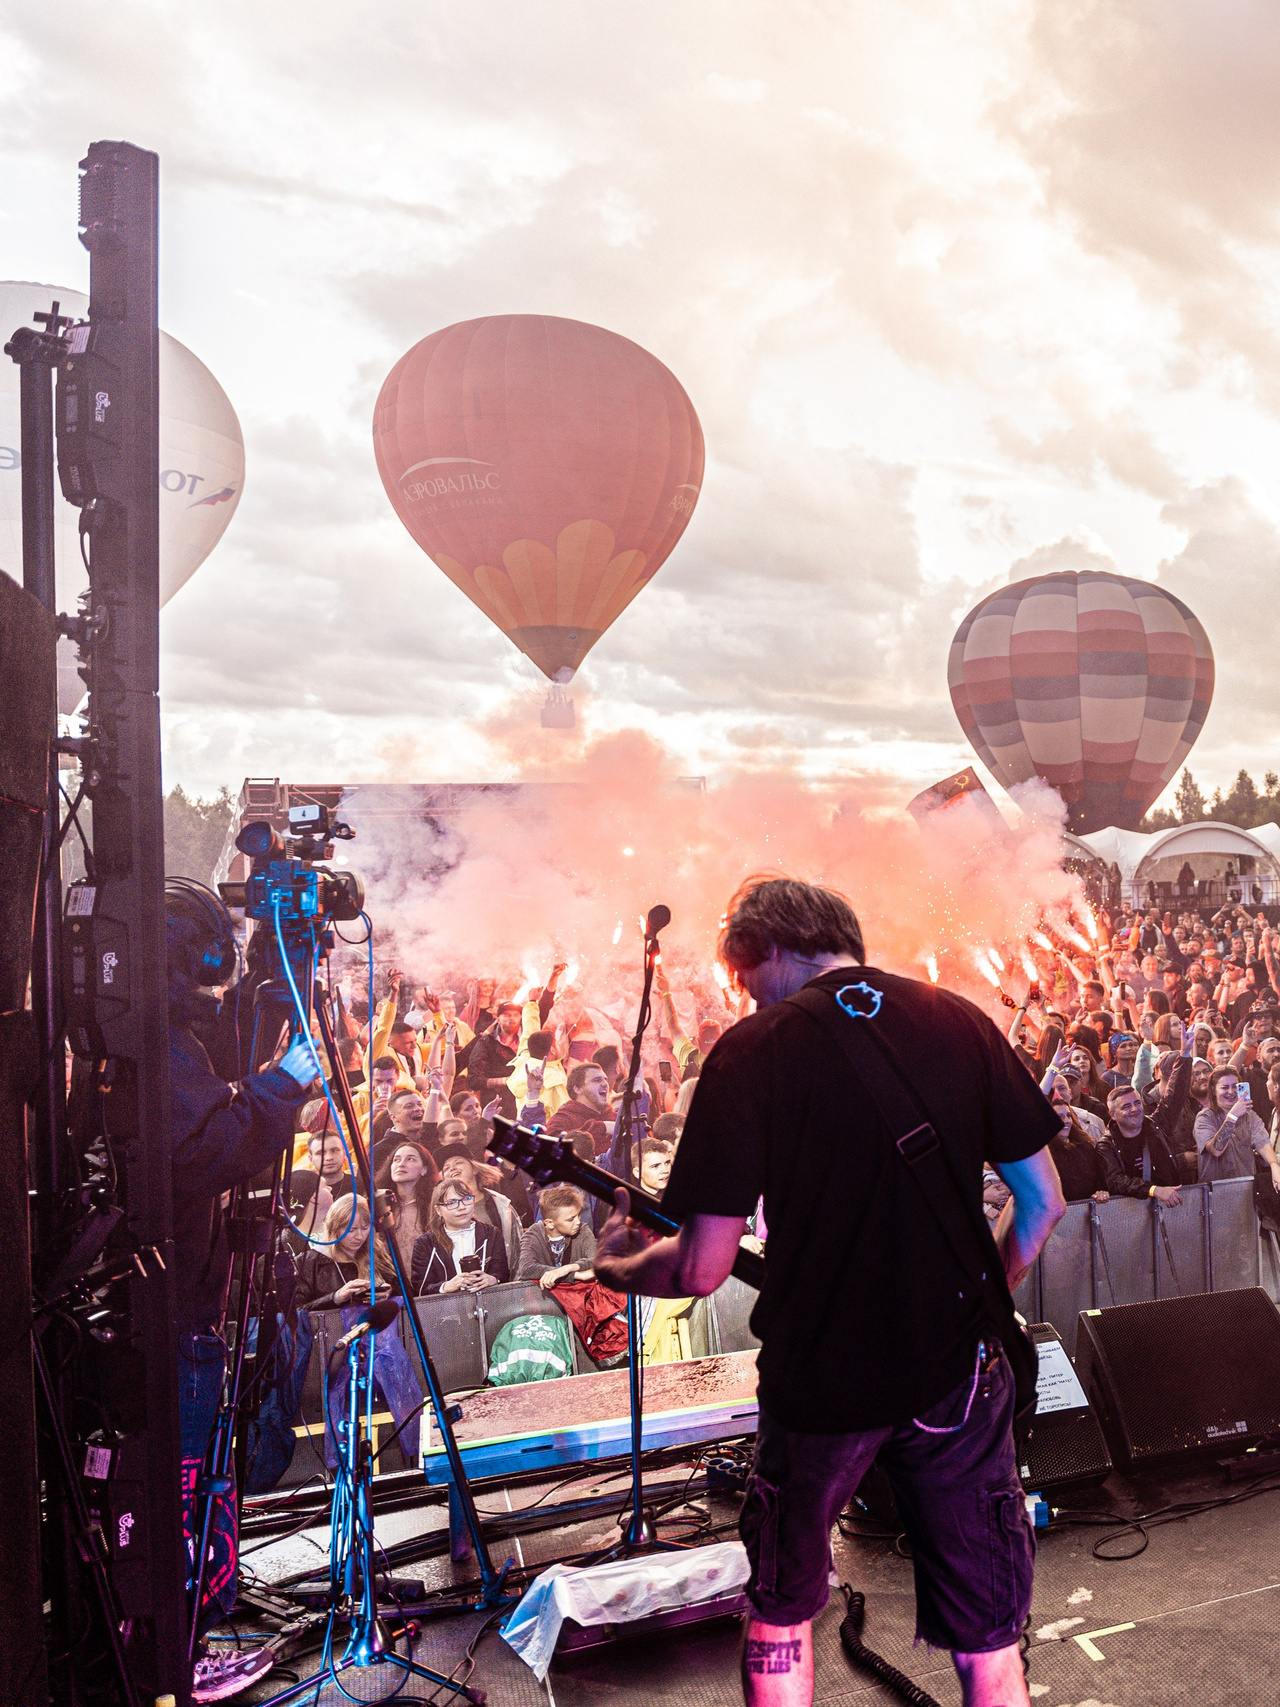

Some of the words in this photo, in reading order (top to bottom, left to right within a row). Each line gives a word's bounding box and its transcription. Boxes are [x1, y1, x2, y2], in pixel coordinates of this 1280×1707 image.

[403, 472, 501, 504] АЭРОВАЛЬС
[301, 809, 306, 818] 4
[767, 1660, 791, 1674] LIES
